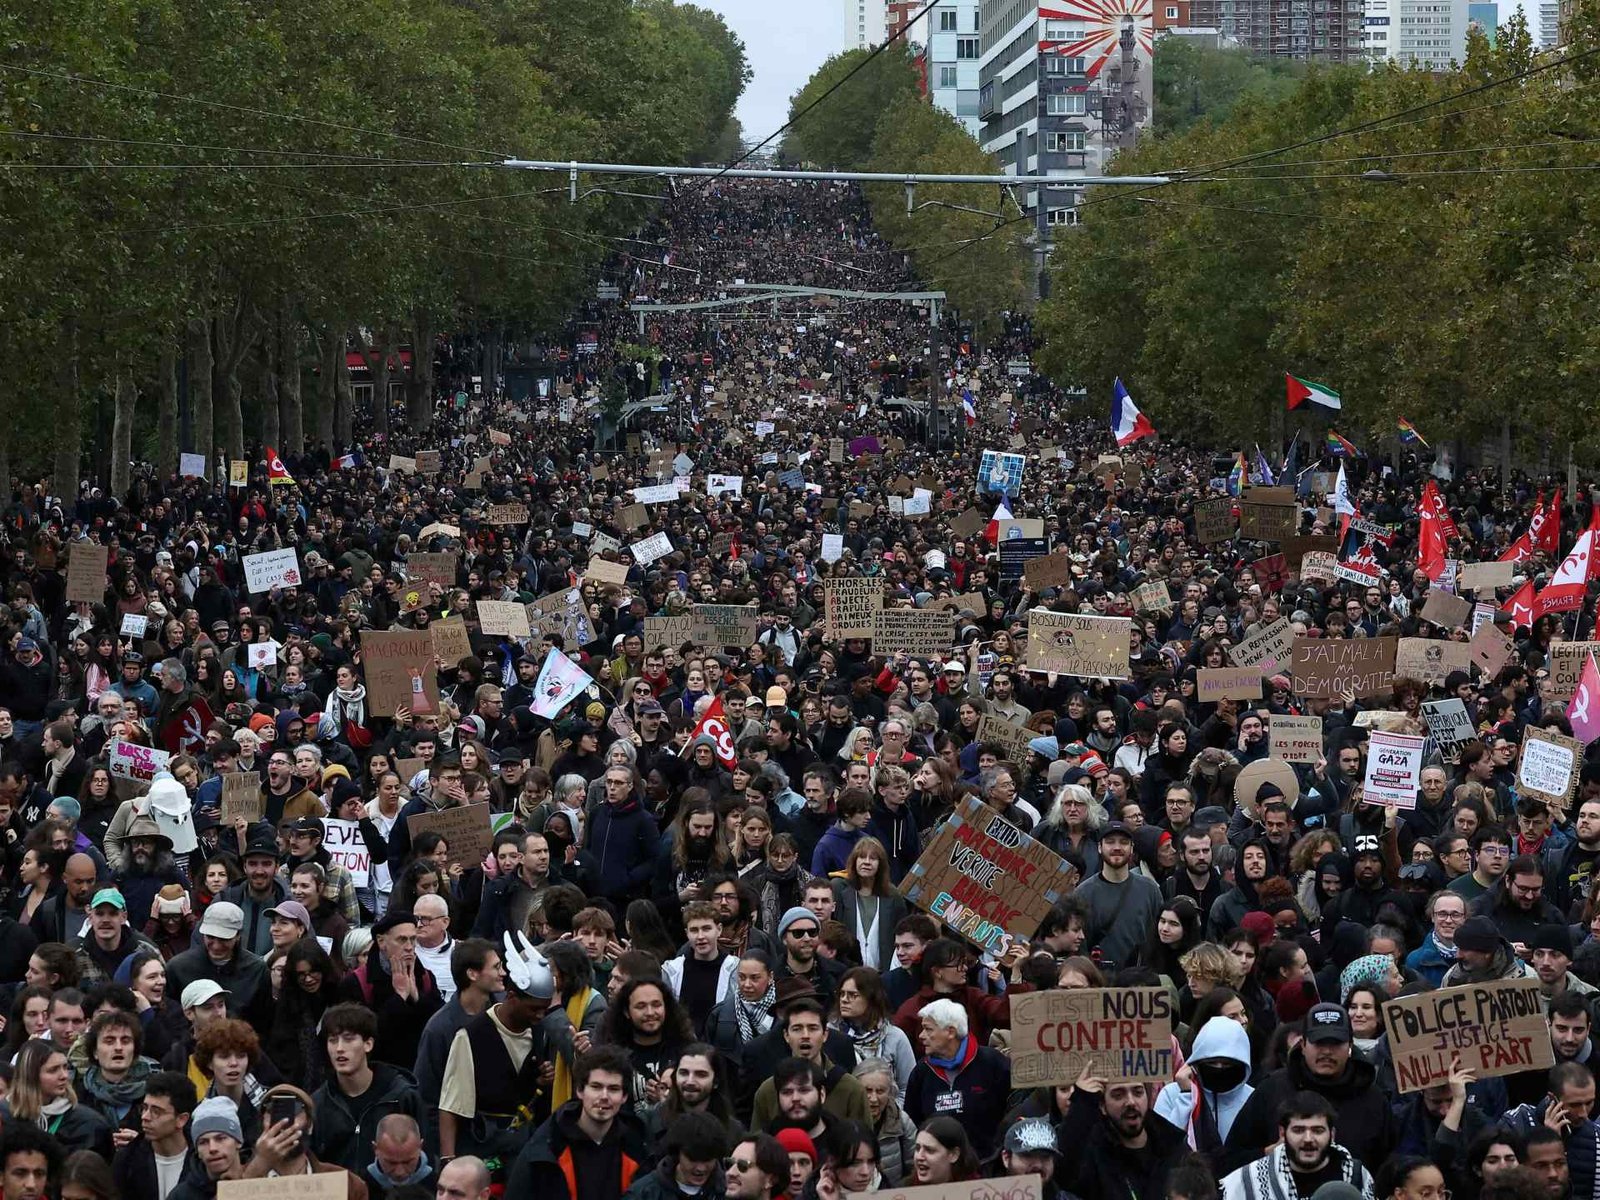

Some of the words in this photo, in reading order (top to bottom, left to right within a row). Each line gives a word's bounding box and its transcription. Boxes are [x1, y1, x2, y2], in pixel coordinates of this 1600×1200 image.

[491, 513, 527, 523] METHOD
[1335, 567, 1344, 576] EST
[1344, 569, 1357, 580] DANS
[1357, 573, 1364, 582] LA
[830, 588, 880, 598] FRAUDEURS
[830, 596, 870, 606] ABJECTS
[831, 603, 876, 614] CRAPULES
[831, 611, 872, 622] HAINEUX
[832, 620, 872, 630] ORDURES
[1273, 638, 1285, 648] LA
[1236, 648, 1248, 660] LA
[1299, 644, 1338, 664] J'AI
[1341, 643, 1370, 663] MAL
[1335, 663, 1355, 674] MA
[1560, 661, 1570, 671] ET
[1294, 672, 1394, 694] DÉMOCRATIE
[1422, 704, 1440, 716] LA
[984, 716, 1009, 736] FRIGO
[1427, 711, 1470, 729] RÉPUBLIQUE
[1432, 728, 1457, 742] C'EST
[1275, 740, 1289, 748] LES
[1292, 739, 1320, 749] FORCES
[1378, 753, 1409, 768] GAZA
[111, 763, 126, 774] SE
[930, 891, 1014, 959] ENFANTS
[1103, 989, 1170, 1020] NOUS
[1387, 993, 1473, 1044] POLICE
[1474, 987, 1542, 1023] PARTOUT
[1037, 1020, 1153, 1053] CONTRE
[1433, 1021, 1512, 1051] JUSTICE
[1121, 1048, 1172, 1077] HAUT
[1397, 1051, 1463, 1092] NULLE
[1479, 1037, 1534, 1070] PART
